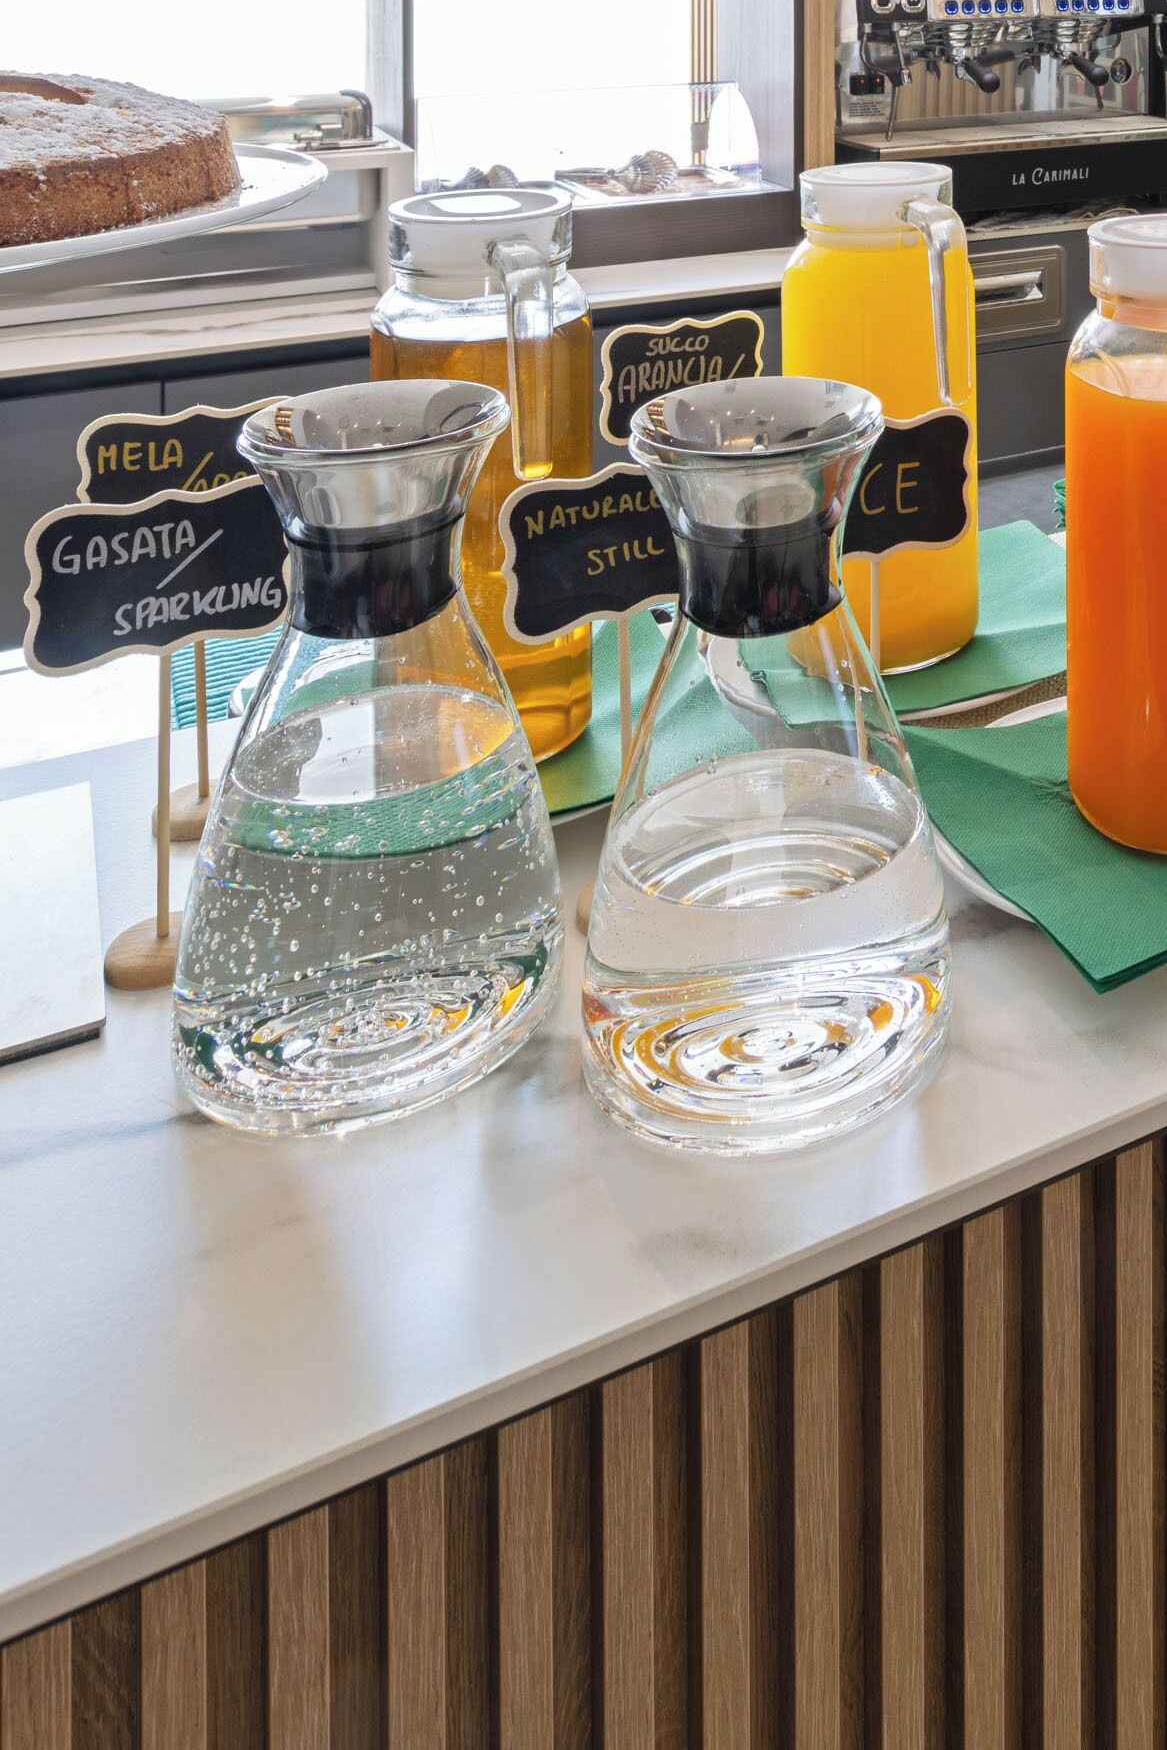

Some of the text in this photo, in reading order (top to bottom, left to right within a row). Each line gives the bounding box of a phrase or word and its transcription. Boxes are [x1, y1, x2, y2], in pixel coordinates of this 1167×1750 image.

[1012, 167, 1089, 185] LA CARIMALI
[645, 335, 710, 357] SUCCO
[860, 461, 920, 515] CE
[524, 490, 661, 540] NATURALE
[587, 536, 665, 576] STILL
[113, 576, 282, 636] SPARKLING
